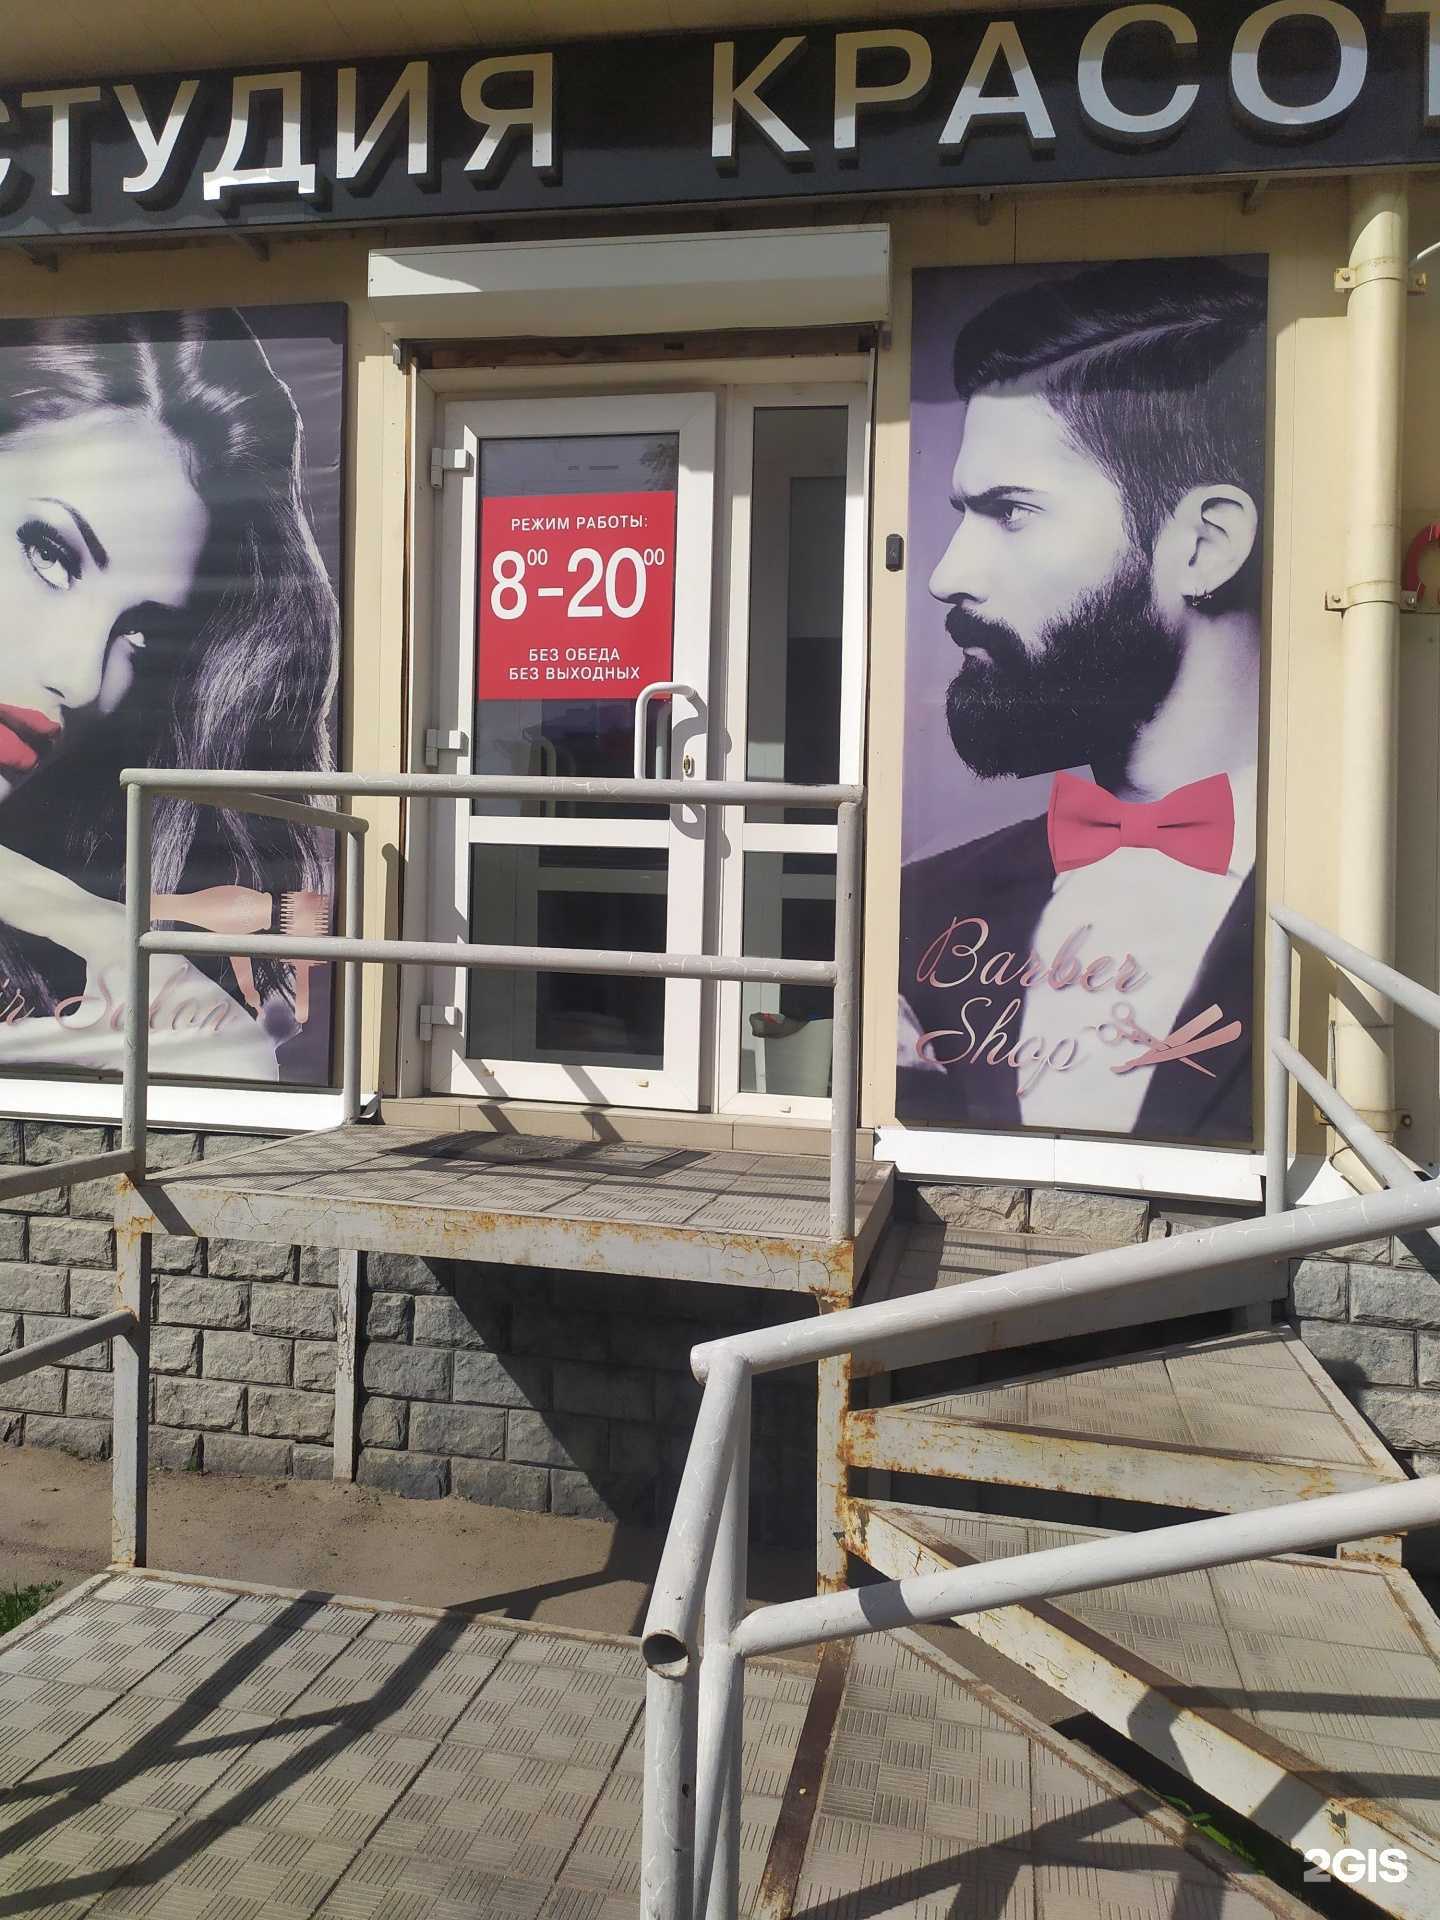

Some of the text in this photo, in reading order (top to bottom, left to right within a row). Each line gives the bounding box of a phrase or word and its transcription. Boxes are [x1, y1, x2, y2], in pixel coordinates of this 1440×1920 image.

[0, 52, 553, 200] ТУДИЯ
[511, 514, 648, 531] РЕЖИМ РАБОТЫ:
[509, 666, 640, 681] БЕЗ ВЫХОДНЫХ
[529, 648, 620, 663] БЕЗ ОБЕДА
[916, 917, 1150, 993] Barber
[915, 997, 1088, 1099] Shop
